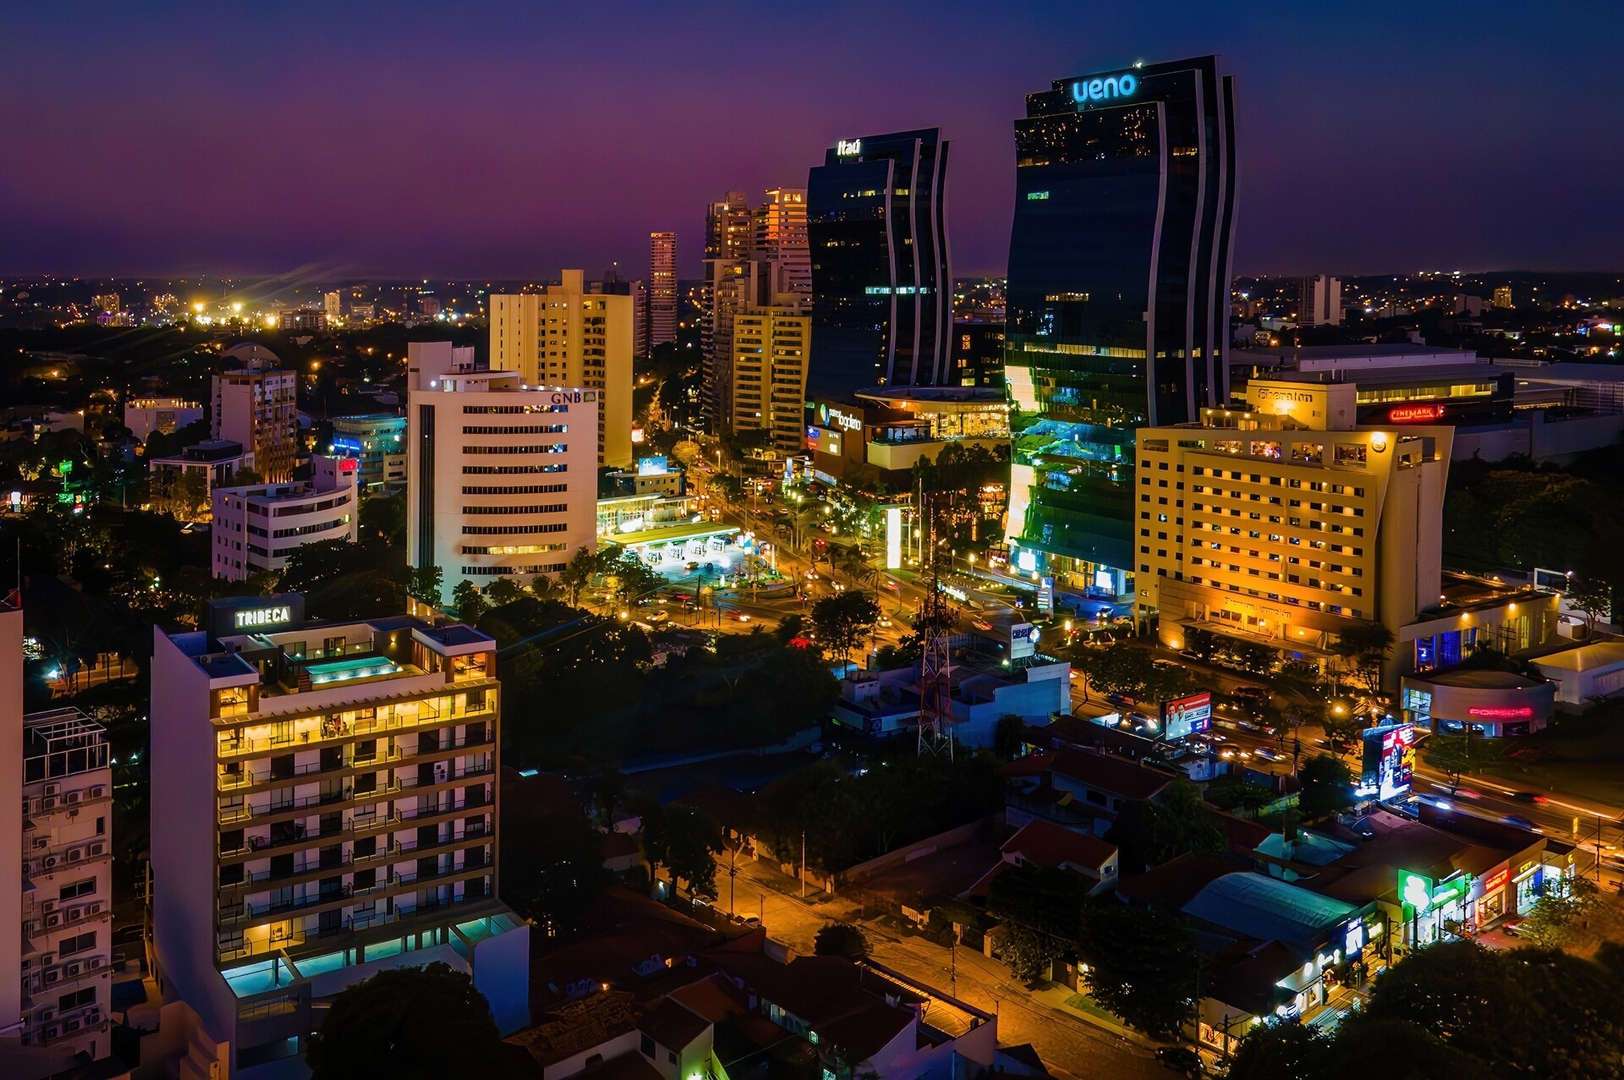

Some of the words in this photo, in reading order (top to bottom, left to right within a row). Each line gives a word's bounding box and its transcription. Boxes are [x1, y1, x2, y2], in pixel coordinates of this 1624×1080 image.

[1073, 74, 1136, 102] ueno
[837, 139, 860, 156] Itaú
[551, 392, 581, 404] GNB
[1391, 408, 1434, 420] CINEMARK
[237, 607, 289, 626] TRIBECA
